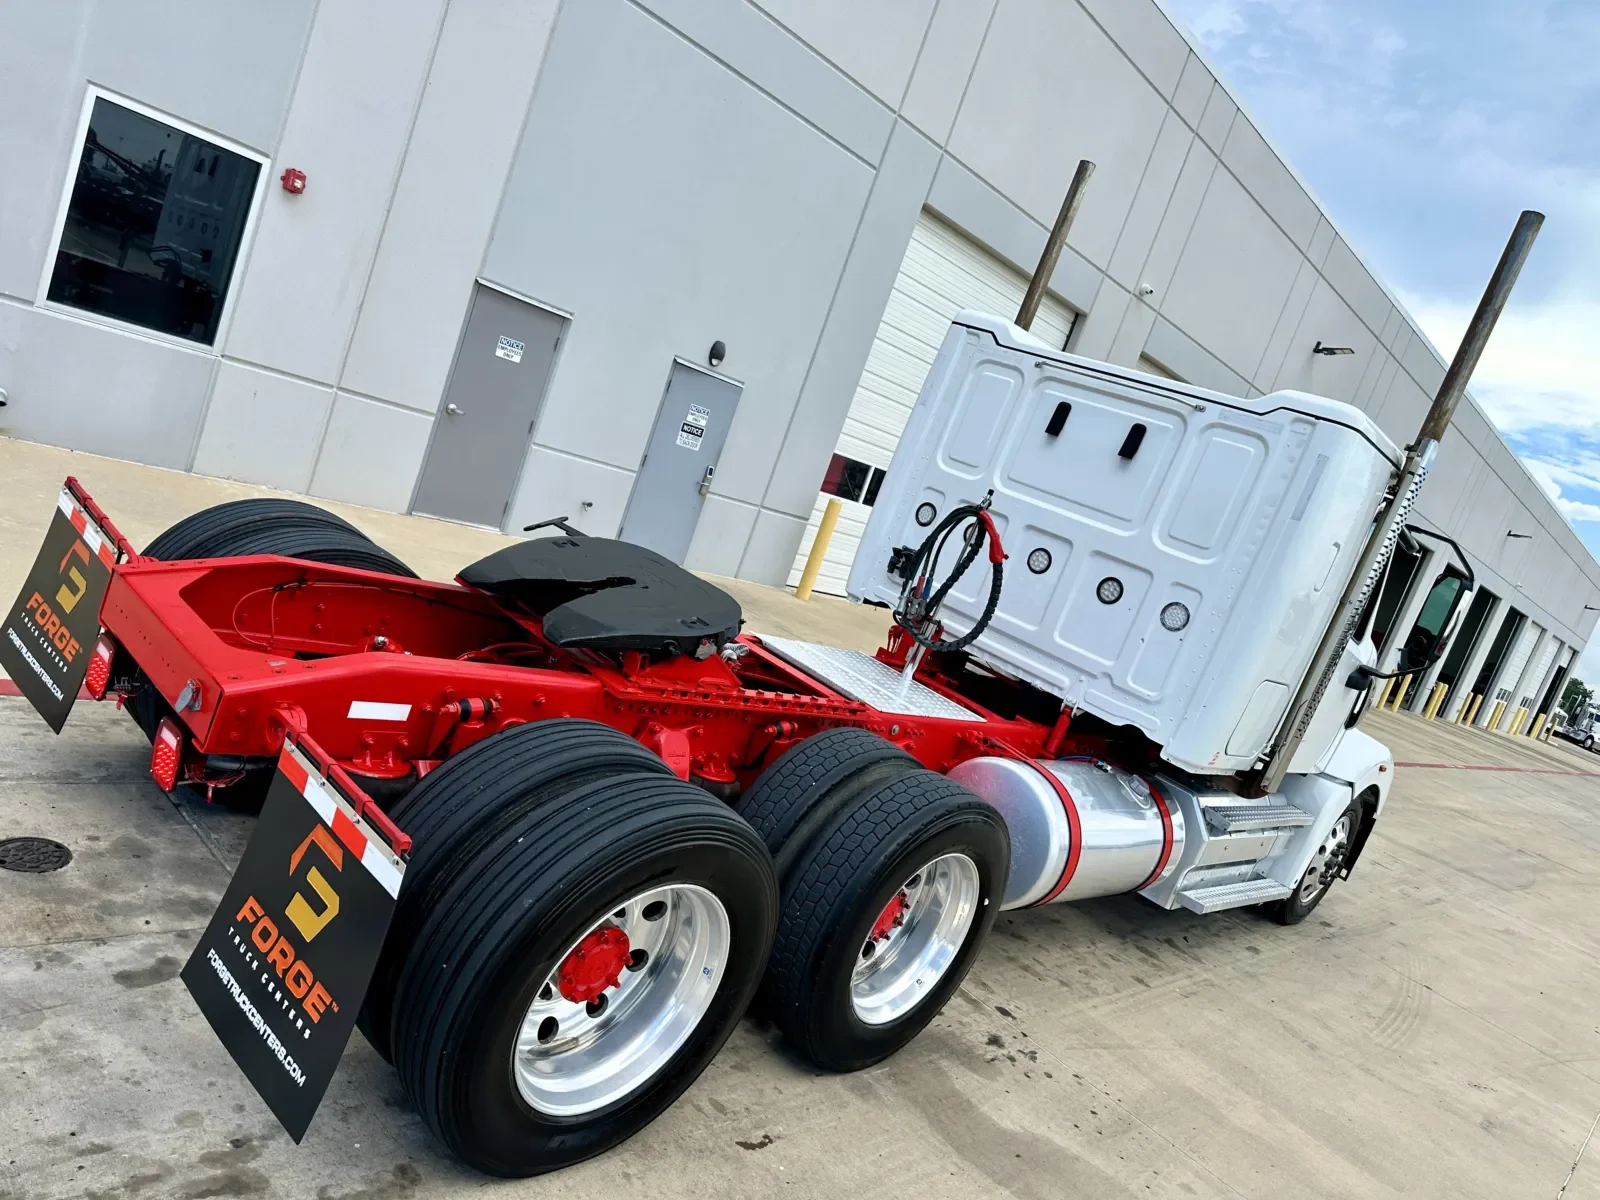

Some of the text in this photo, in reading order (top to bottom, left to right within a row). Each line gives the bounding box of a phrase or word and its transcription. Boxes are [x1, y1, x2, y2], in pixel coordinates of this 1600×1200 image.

[500, 337, 524, 351] NOTICE
[682, 424, 703, 436] NOTICE
[691, 405, 709, 416] NOTICE
[20, 611, 68, 674] TRUCK CENTERS
[26, 591, 80, 663] FORGE
[7, 627, 65, 701] FORGETRUCKCENTERS.COM
[228, 926, 312, 1040] TRUCK CENTERS
[235, 895, 333, 1024] FORGE
[207, 948, 307, 1088] FORGETRUCKCENTERS.COM
